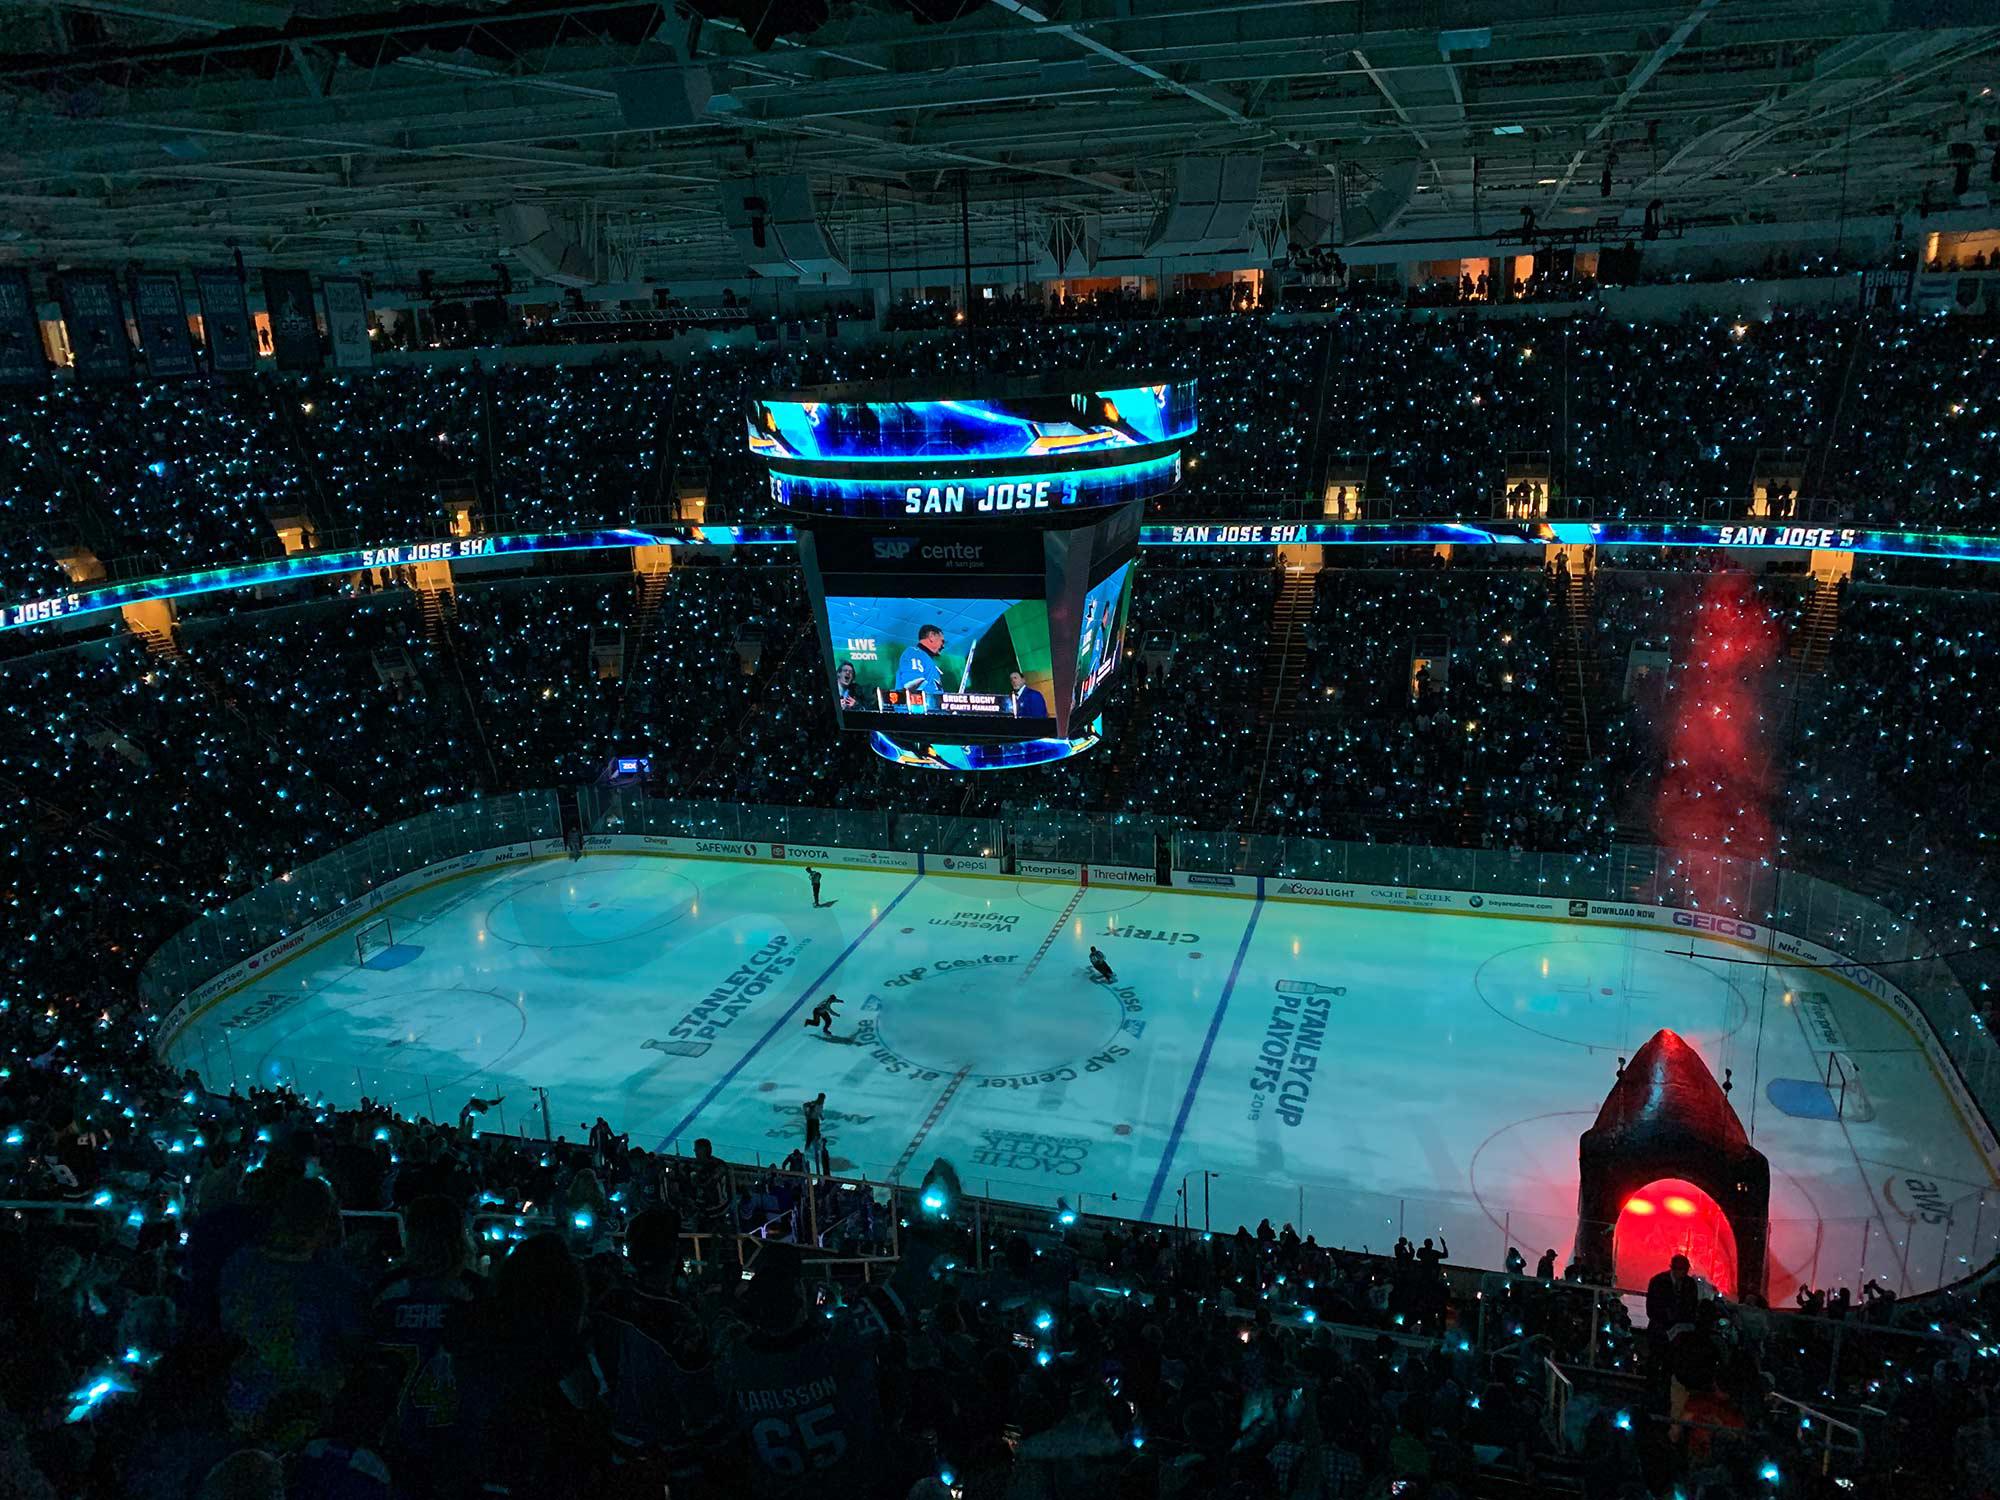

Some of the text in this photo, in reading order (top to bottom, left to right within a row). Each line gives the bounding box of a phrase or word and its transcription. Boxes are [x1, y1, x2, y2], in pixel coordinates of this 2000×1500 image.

[1864, 271, 1908, 287] BRING
[905, 486, 963, 514] SAN
[977, 480, 1051, 512] JOSE
[1170, 524, 1308, 543] SAN JOSE SHA
[1718, 526, 1768, 545] SAN
[1774, 528, 1834, 548] JOSE
[362, 538, 495, 567] SAN JOSE SHA
[872, 541, 983, 559] SAP center
[13, 597, 64, 625] JOSE
[847, 638, 876, 651] LIVE
[849, 652, 878, 661] zoom
[911, 657, 924, 673] 15
[942, 693, 968, 705] BRUCE
[695, 841, 743, 854] SAFEWAY
[788, 848, 829, 860] TOYOTA
[957, 860, 987, 871] pepsi
[1094, 869, 1158, 883] ThreatMetri
[1291, 882, 1355, 898] Coors LIGHT
[1418, 893, 1452, 903] CREEK
[953, 912, 1020, 923] Digital
[1591, 906, 1636, 916] DOWNLOAD
[1637, 909, 1655, 919] NOW
[928, 918, 1011, 932] Western
[1673, 911, 1756, 940] GEICO
[668, 935, 788, 1039] STANLEY CUP
[1829, 953, 1887, 999] zoom
[695, 956, 795, 1040] PLAYOFFS
[1112, 986, 1143, 1012] Jose
[855, 1019, 879, 1047] Jose
[870, 1048, 909, 1073] San
[976, 1045, 1130, 1090] SAP Center
[1248, 995, 1302, 1121] PLAYOFFS 2019
[1275, 996, 1331, 1127] STANLEY CUP
[1904, 1179, 1947, 1225] aws
[735, 1375, 838, 1411] KARLSSON
[752, 1404, 849, 1475] 65
